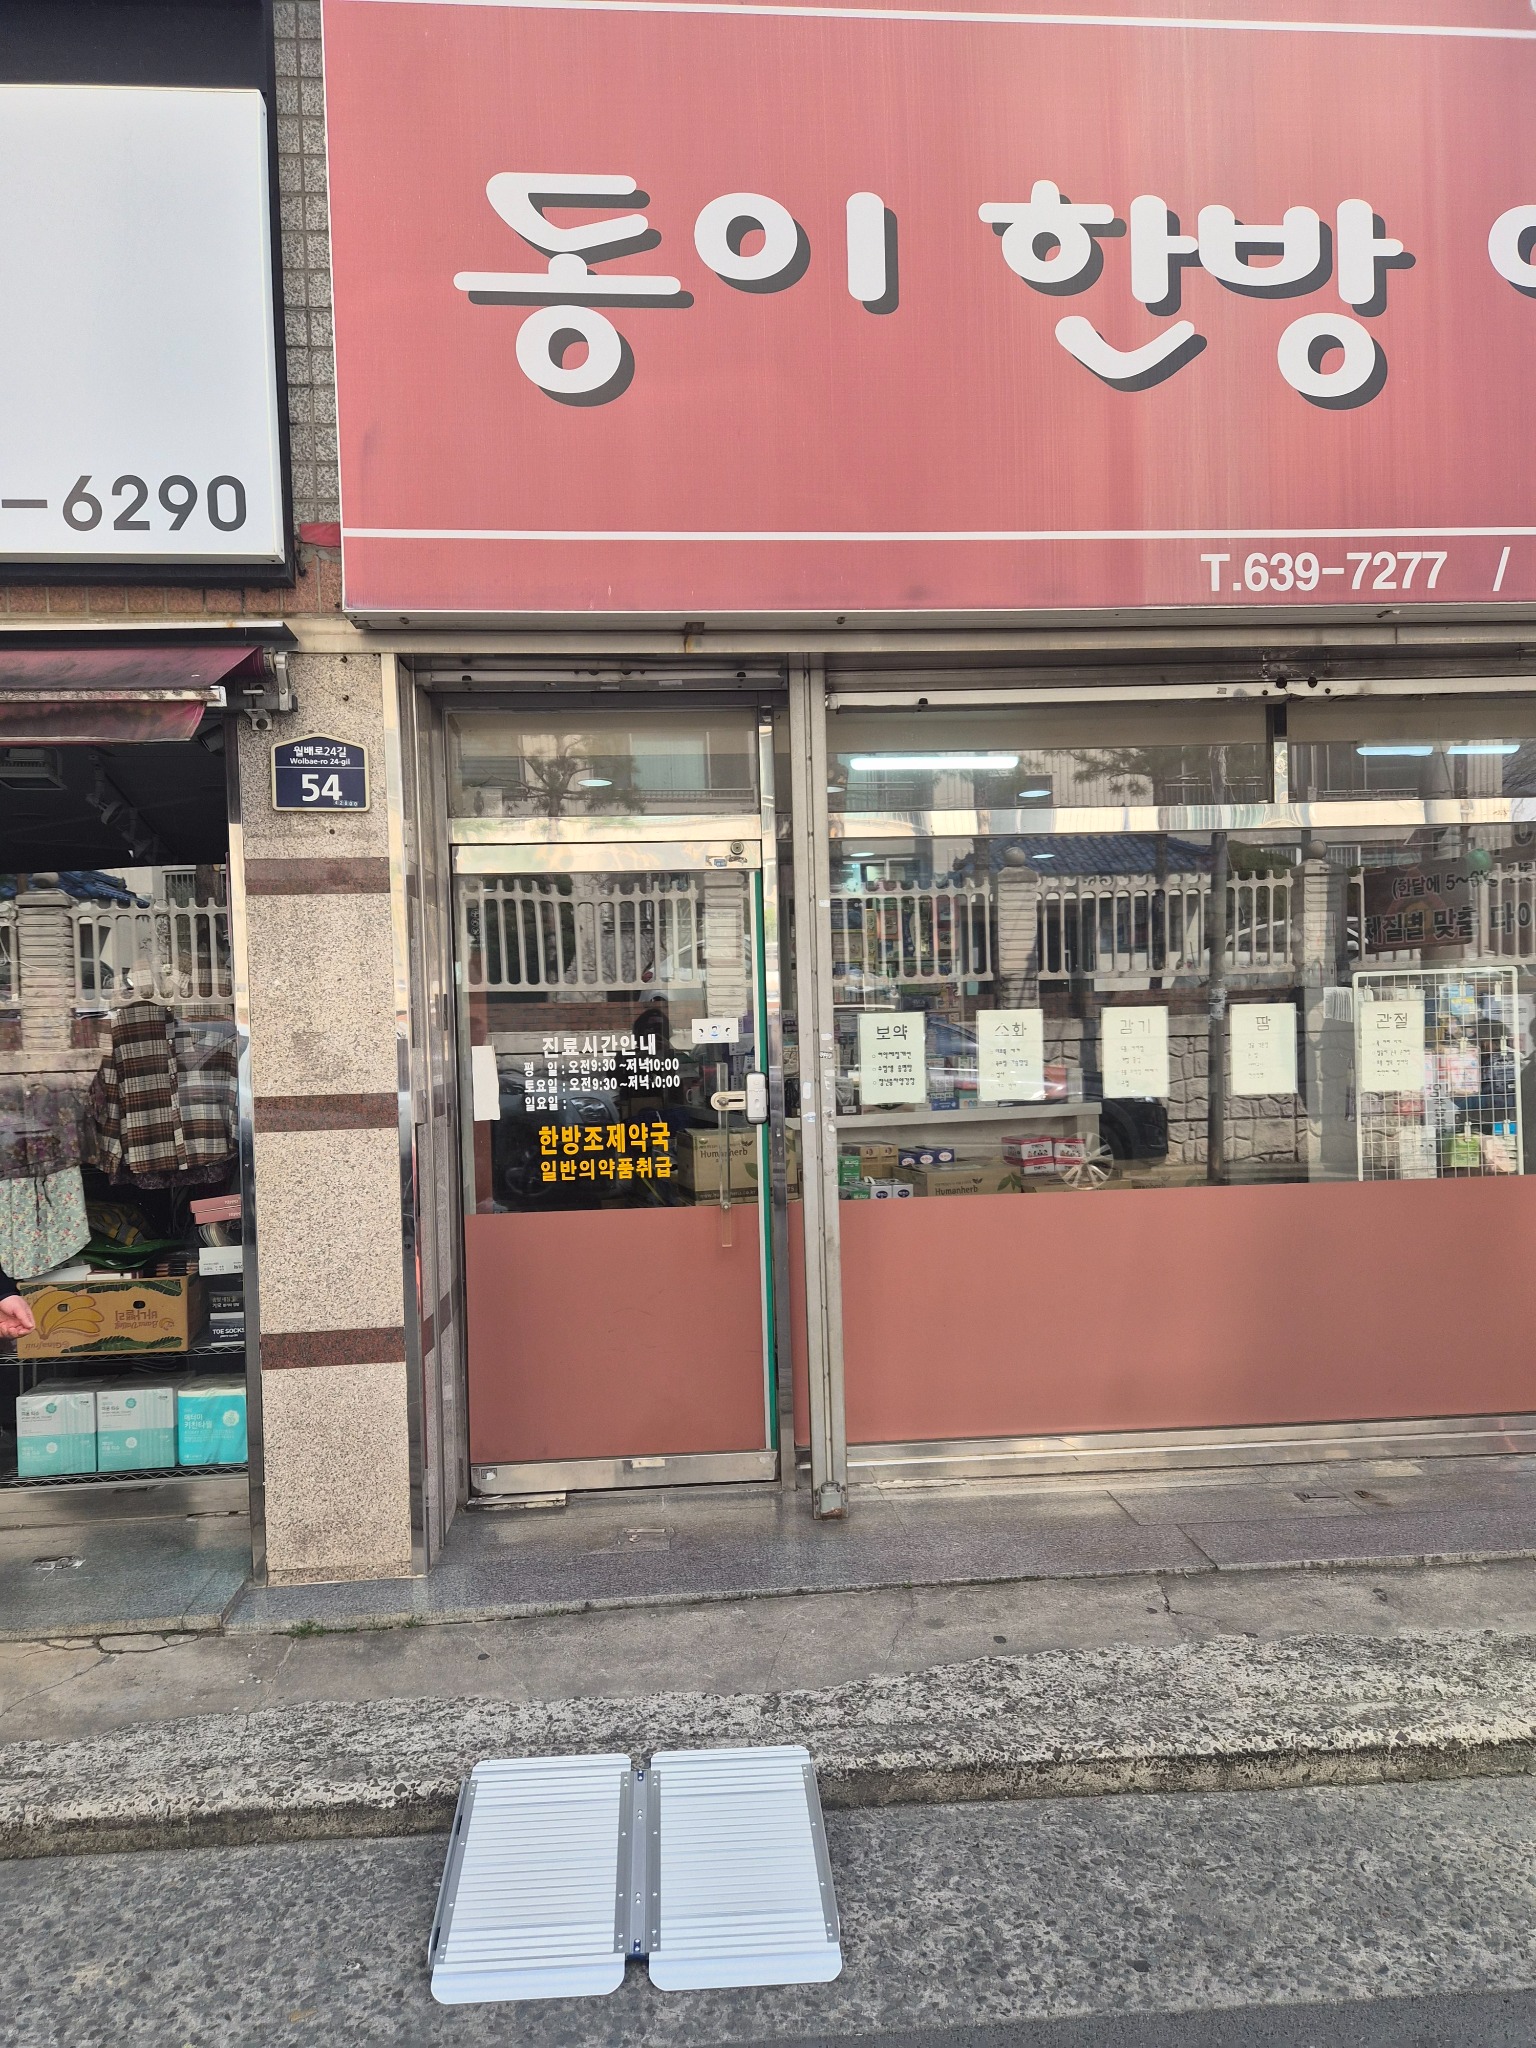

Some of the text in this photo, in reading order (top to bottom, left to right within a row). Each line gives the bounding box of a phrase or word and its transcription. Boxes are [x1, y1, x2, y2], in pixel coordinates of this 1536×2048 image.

[453, 172, 898, 407] 동이
[978, 180, 1416, 411] 한방
[1200, 552, 1447, 592] T.639-7277
[293, 746, 346, 757] 월배로24길
[329, 758, 350, 766] 24-gil
[302, 773, 342, 802] 54
[995, 1021, 1027, 1036] 소화
[1120, 1018, 1150, 1034] 감기
[1255, 1015, 1271, 1031] 땀
[1376, 1012, 1407, 1029] 관절
[876, 1024, 908, 1040] 보약
[542, 1033, 656, 1059] 진료시간안내
[524, 1079, 557, 1093] 토요일
[525, 1096, 558, 1111] 일요일
[539, 1122, 671, 1155] 한방조제약국
[541, 1156, 672, 1182] 일반의약품취급
[935, 1185, 978, 1196] Humanherb
